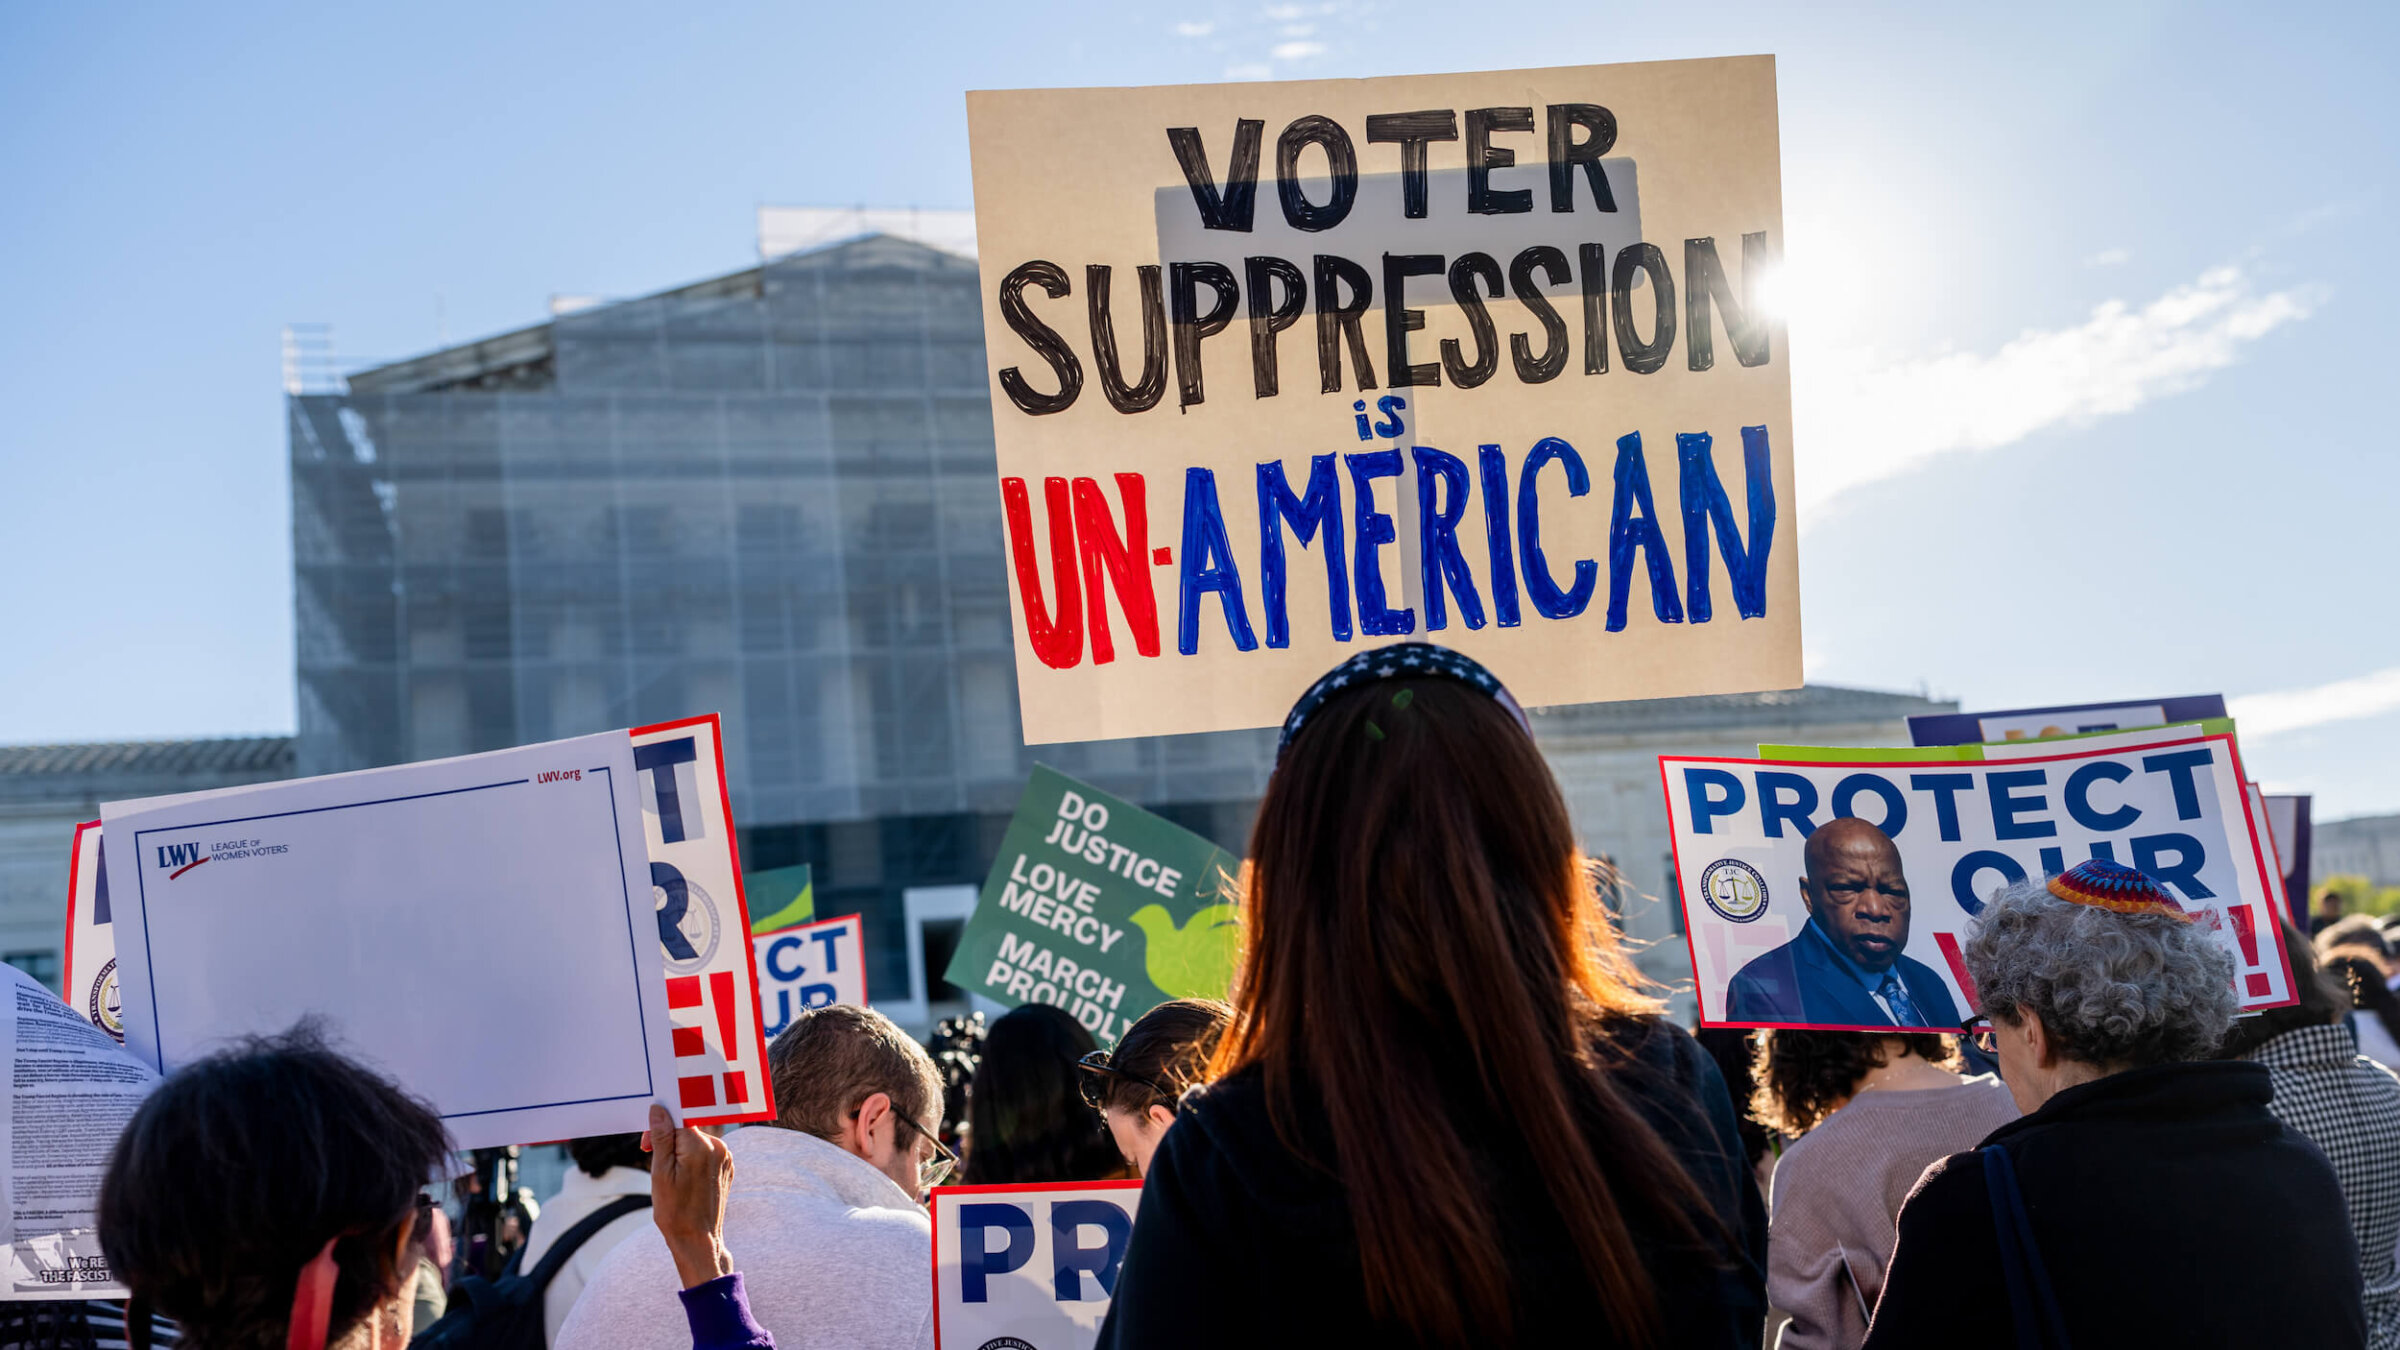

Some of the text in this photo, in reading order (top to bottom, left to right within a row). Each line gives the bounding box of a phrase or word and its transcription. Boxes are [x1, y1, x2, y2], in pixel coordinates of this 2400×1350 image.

[1166, 102, 1619, 234] VOTER
[998, 230, 1772, 416] SUPPRESSION
[1354, 394, 1407, 442] is
[1001, 424, 1777, 670] UN-AMERICAN
[537, 769, 581, 784] LWV.org
[1683, 747, 2215, 841] PROTECT
[1057, 791, 1110, 832] DO
[156, 842, 201, 868] LWV
[211, 840, 248, 852] LEAGUE
[212, 845, 289, 861] WOMEN VOTERS
[1045, 819, 1182, 898] JUSTICE
[1951, 832, 2217, 917] OR
[1010, 854, 1102, 914] LOVE
[998, 881, 1125, 953] MERCY
[997, 932, 1126, 1010] MARCH
[42, 1270, 111, 1282] THE FASCIST
[89, 1257, 108, 1269] RE
